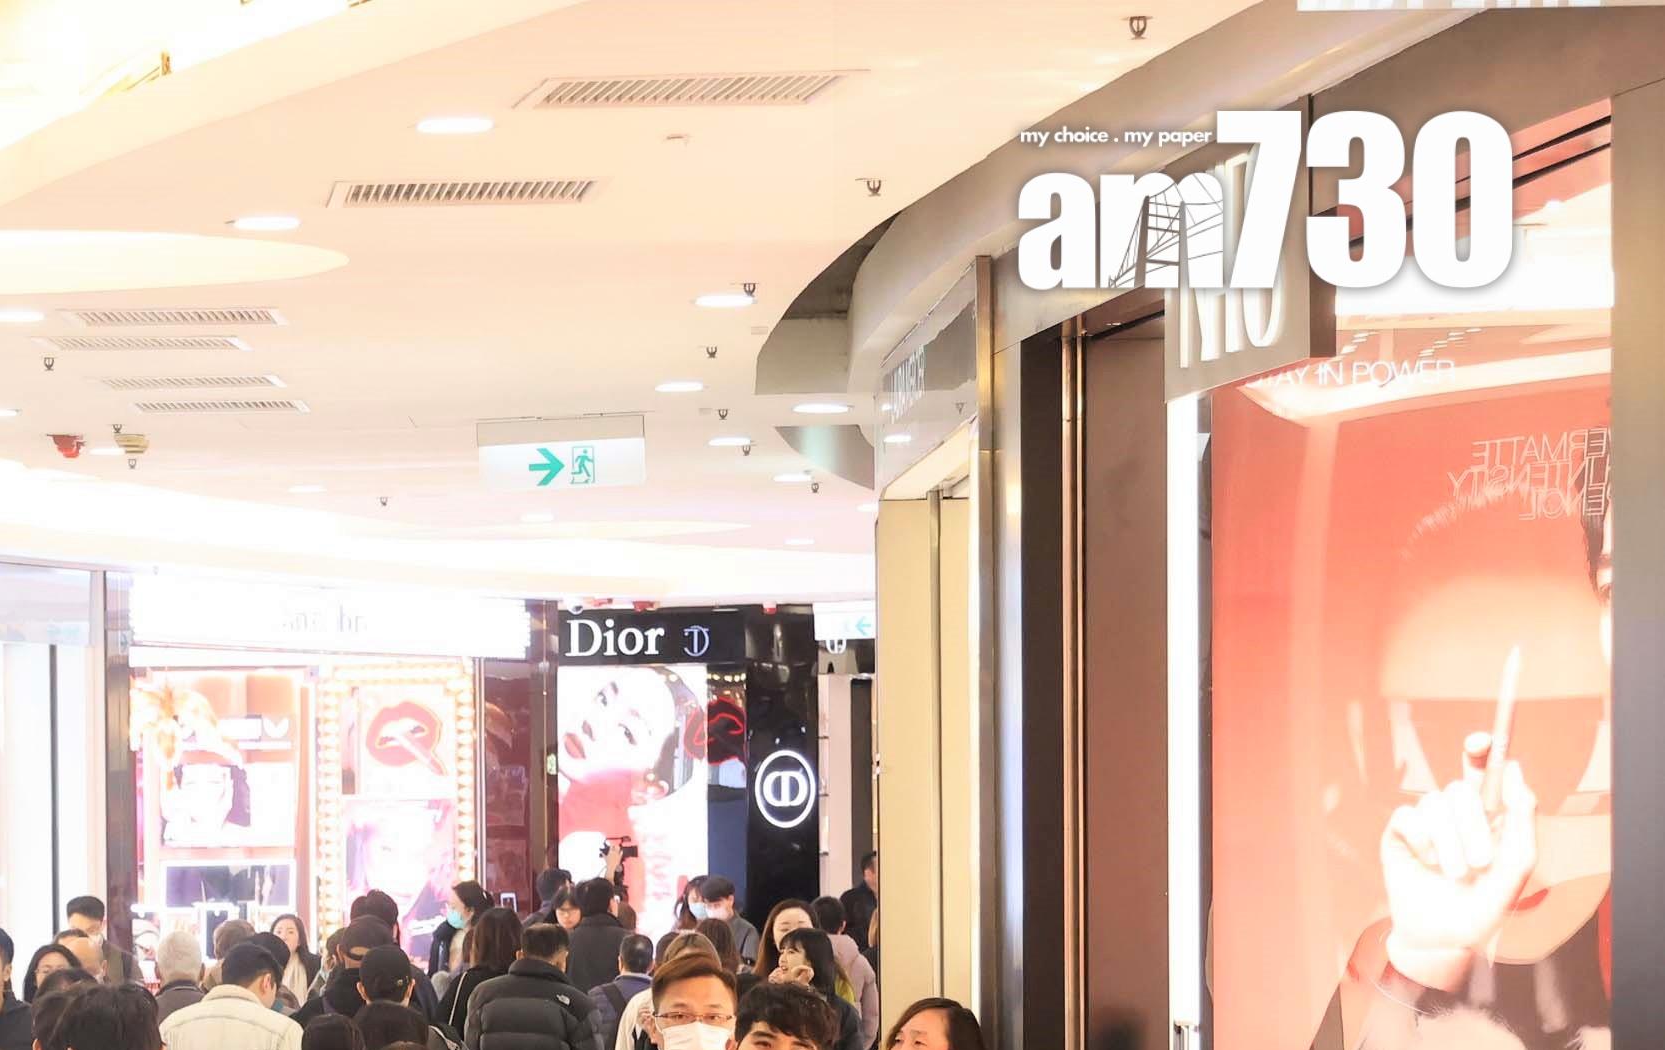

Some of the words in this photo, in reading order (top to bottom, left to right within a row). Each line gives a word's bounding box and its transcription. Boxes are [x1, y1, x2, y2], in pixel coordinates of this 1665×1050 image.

[1317, 361, 1344, 385] IN
[1352, 358, 1456, 385] POWER
[565, 618, 665, 657] Dior
